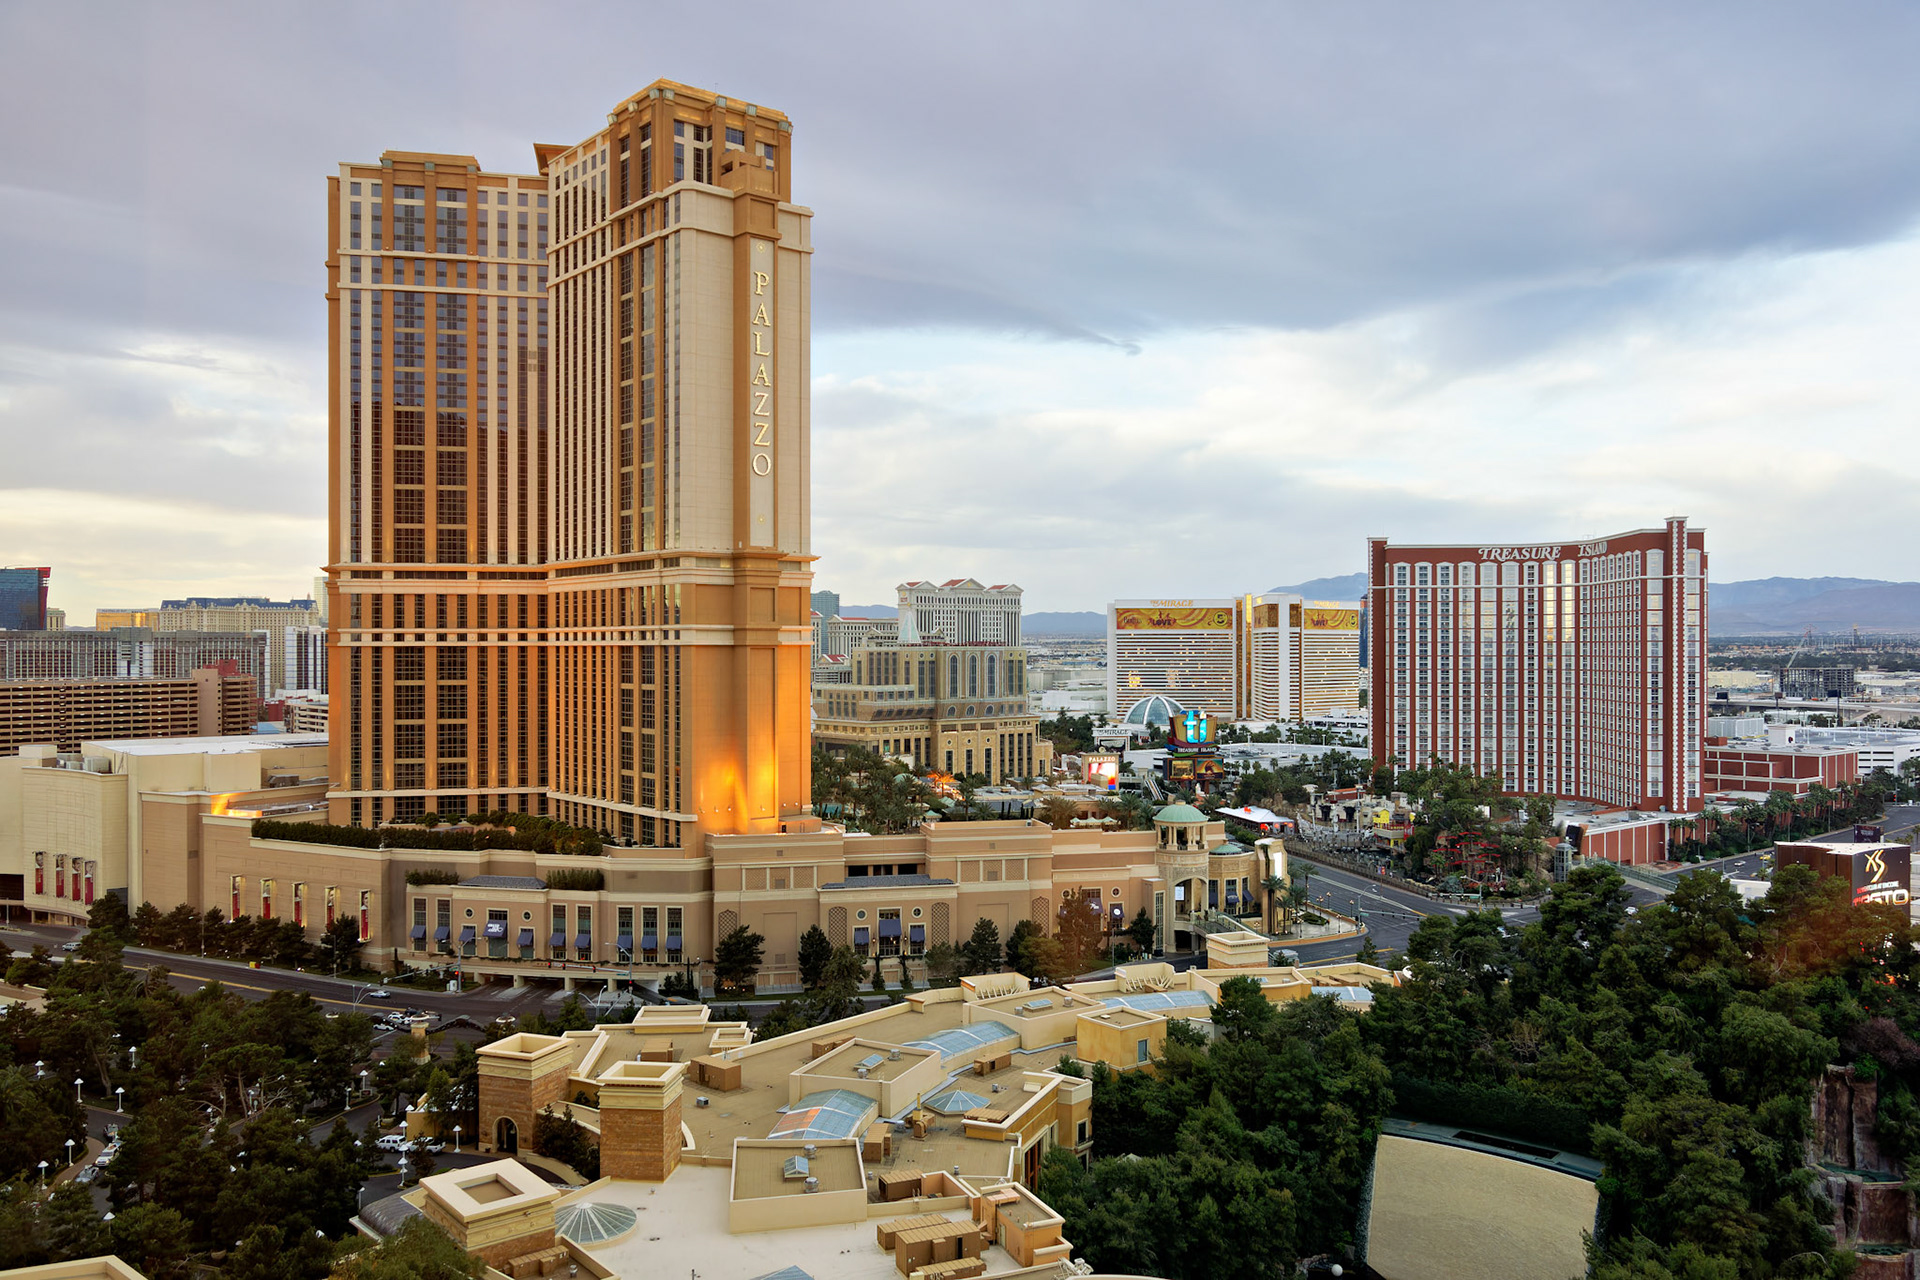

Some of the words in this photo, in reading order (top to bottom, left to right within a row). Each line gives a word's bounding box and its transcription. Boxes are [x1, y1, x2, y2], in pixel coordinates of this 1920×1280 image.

[752, 271, 771, 476] PALAZZO
[1478, 547, 1561, 562] TREASURE
[1578, 542, 1607, 557] ISLAND
[1864, 849, 1886, 883] XS
